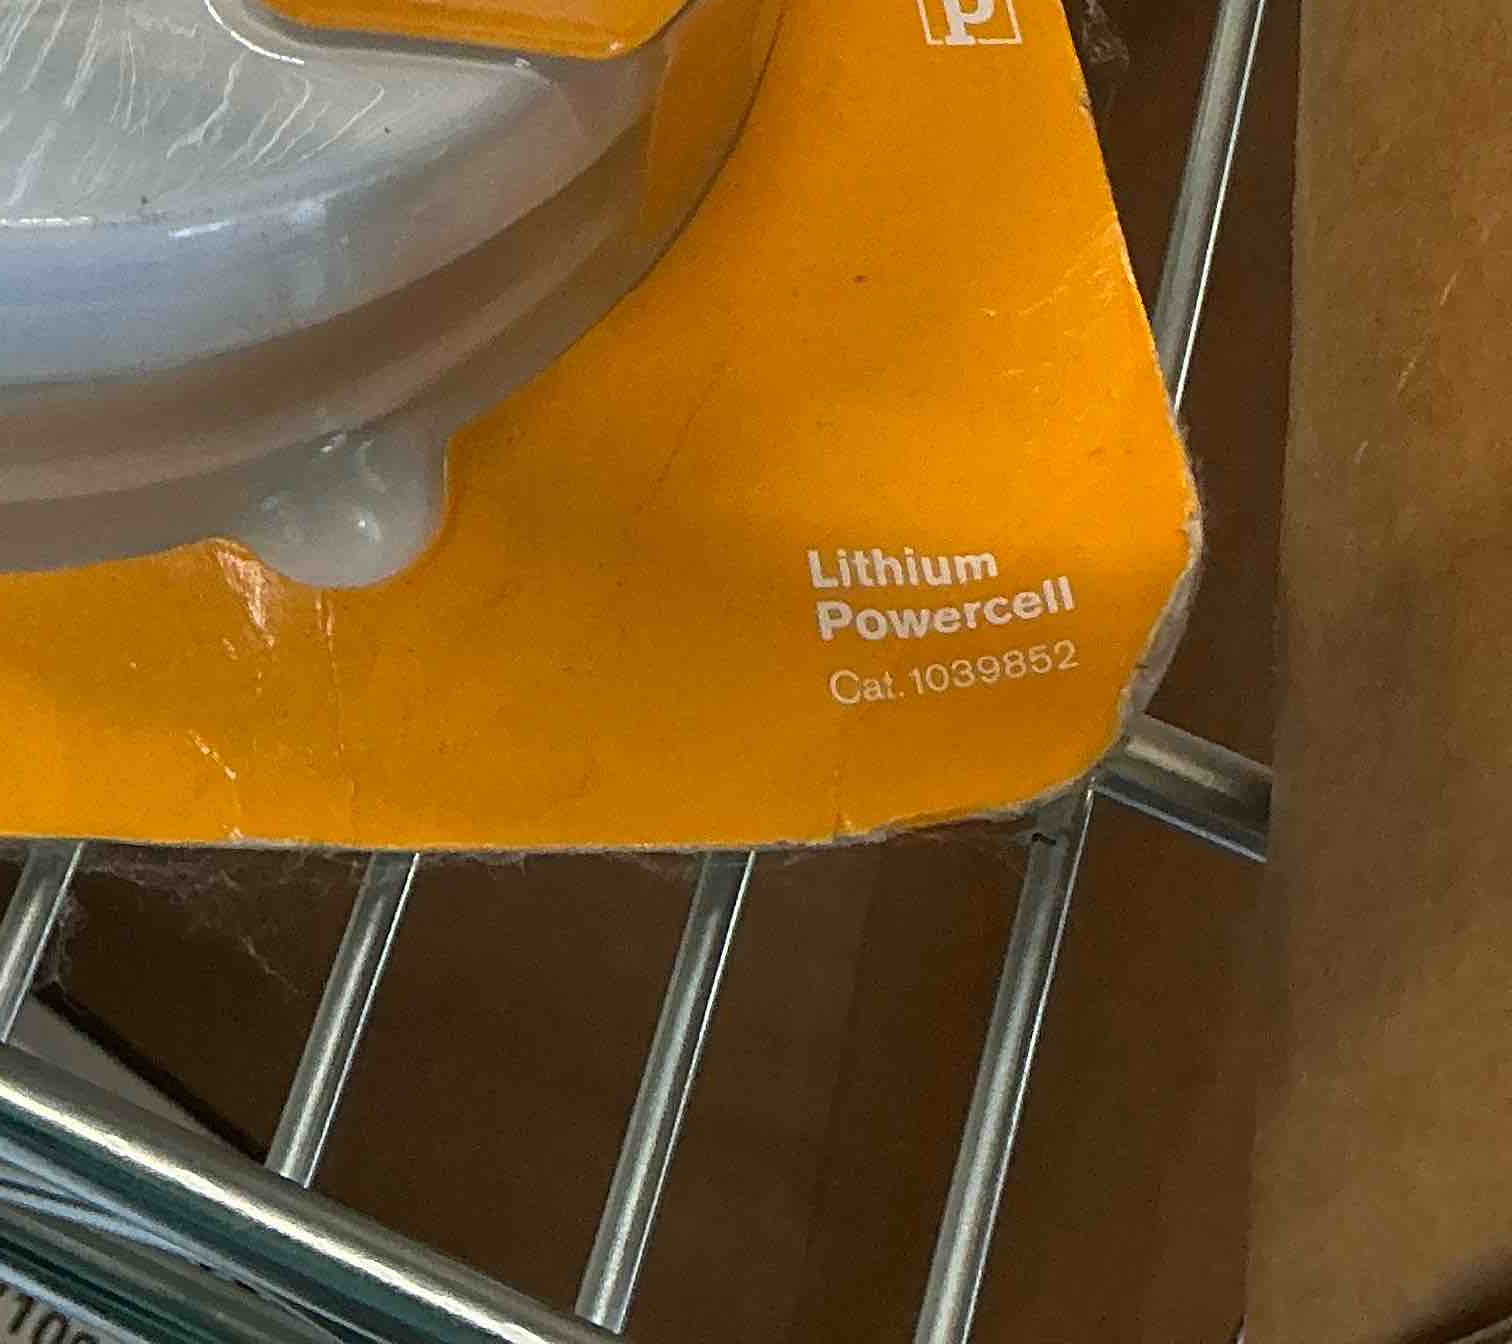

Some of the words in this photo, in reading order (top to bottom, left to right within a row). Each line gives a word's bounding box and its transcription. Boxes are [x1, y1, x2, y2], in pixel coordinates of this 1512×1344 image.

[807, 545, 999, 589] Lithium
[815, 574, 1077, 641] Powercell
[828, 670, 906, 705] Cat.
[908, 639, 1081, 696] 1039852
